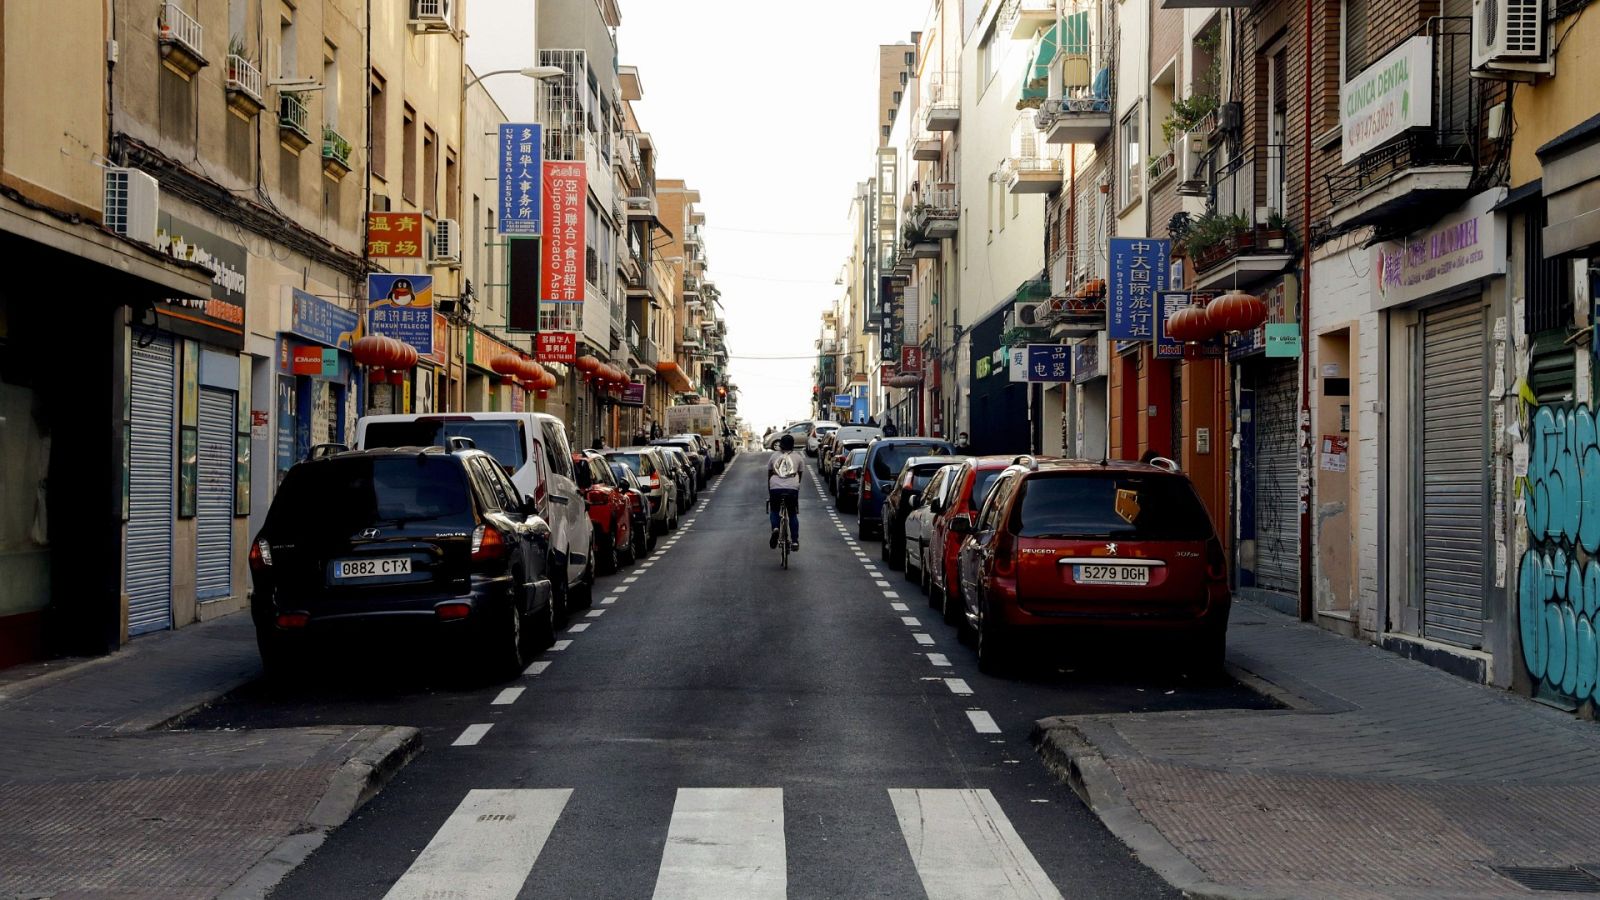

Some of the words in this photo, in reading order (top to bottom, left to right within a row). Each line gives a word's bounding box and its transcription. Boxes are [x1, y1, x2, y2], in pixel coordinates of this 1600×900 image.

[1377, 56, 1409, 98] DENTAL
[1354, 101, 1395, 142] 914763069
[505, 128, 513, 173] UNIVERSO
[518, 127, 533, 220] 多丽华人事务所
[504, 174, 513, 219] ASESORIA
[551, 178, 564, 270] Supermercado
[368, 240, 418, 256] 商场
[1115, 253, 1123, 270] TEL
[1157, 242, 1165, 273] VIAJES
[550, 272, 561, 300] Asia
[1128, 241, 1152, 337] 中天国际旅行社
[373, 310, 429, 323] 腾讯科技
[400, 322, 430, 330] TELECOM
[1158, 344, 1182, 355] Móvil
[1034, 362, 1066, 378] 电器
[342, 561, 376, 576] 0882
[381, 559, 409, 574] CTX
[1084, 566, 1117, 580] 5279
[1121, 567, 1146, 581] DGH
